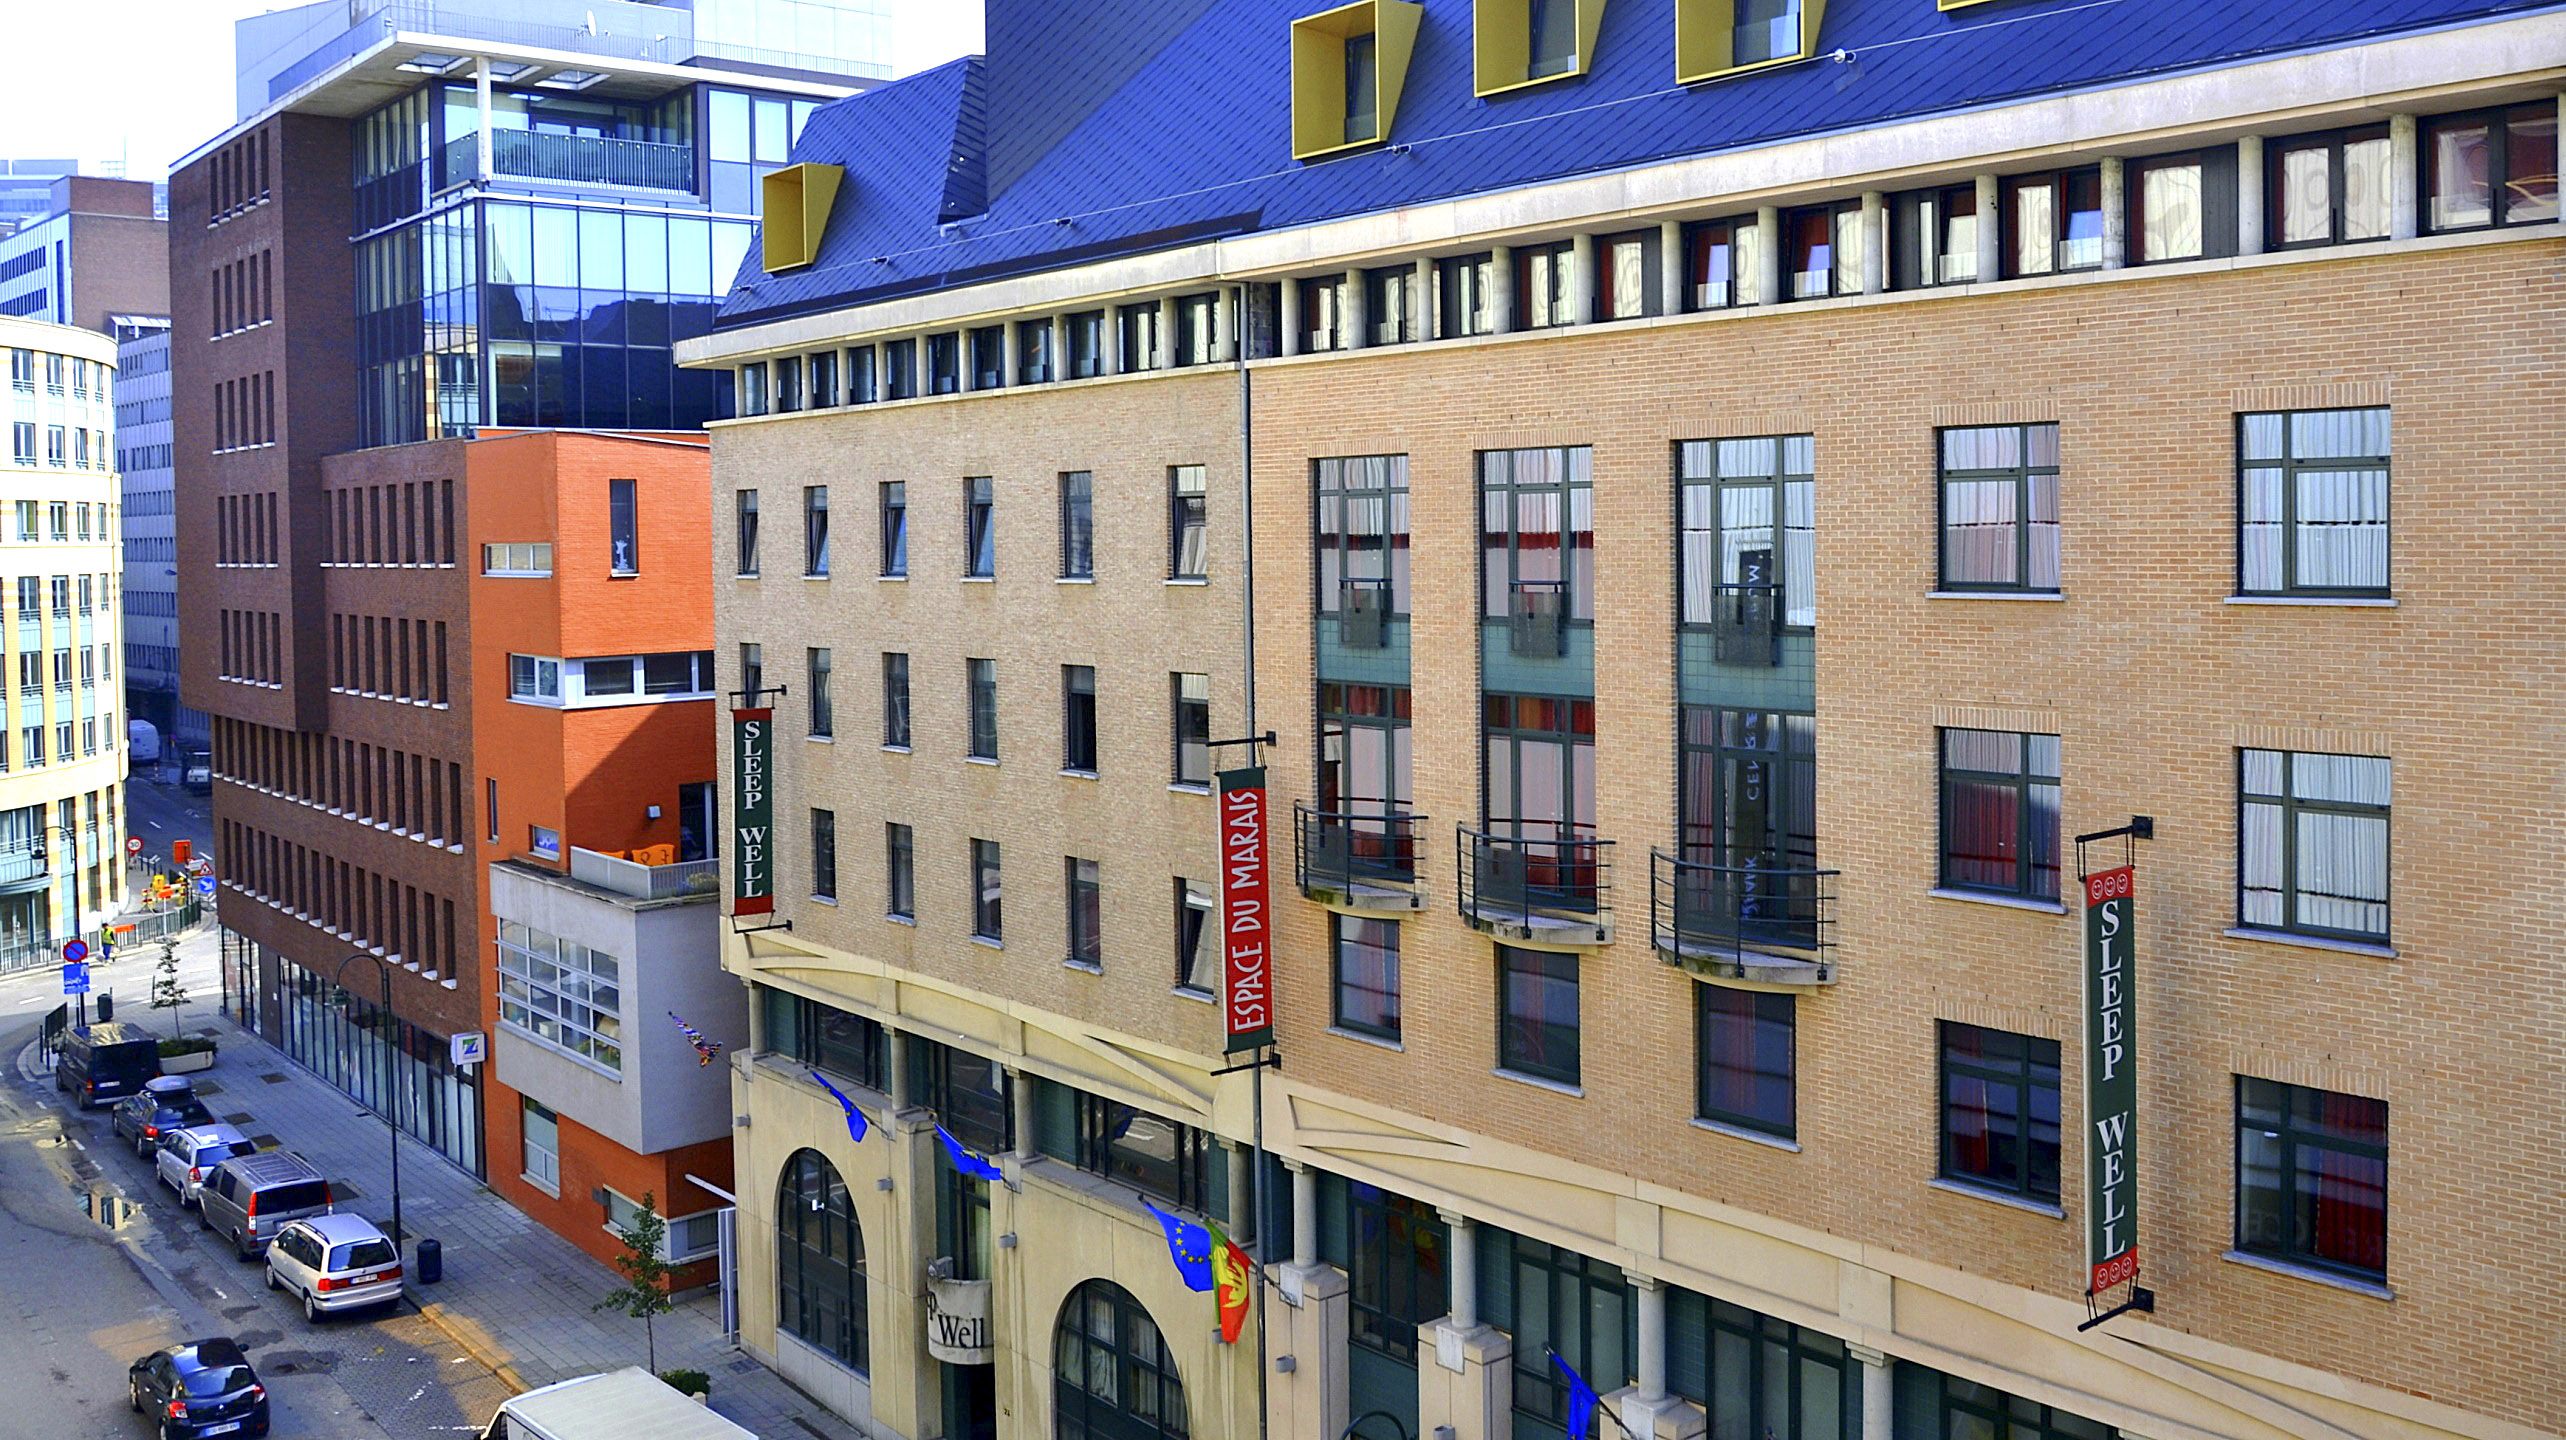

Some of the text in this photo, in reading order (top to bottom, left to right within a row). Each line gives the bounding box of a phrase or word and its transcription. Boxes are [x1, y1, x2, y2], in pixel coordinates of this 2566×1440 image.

[739, 721, 767, 898] SLEEP WELL
[1228, 791, 1265, 1031] ESPACE DU MARAIS
[2096, 899, 2129, 1260] SLEEP WELL
[937, 1313, 985, 1349] Well
